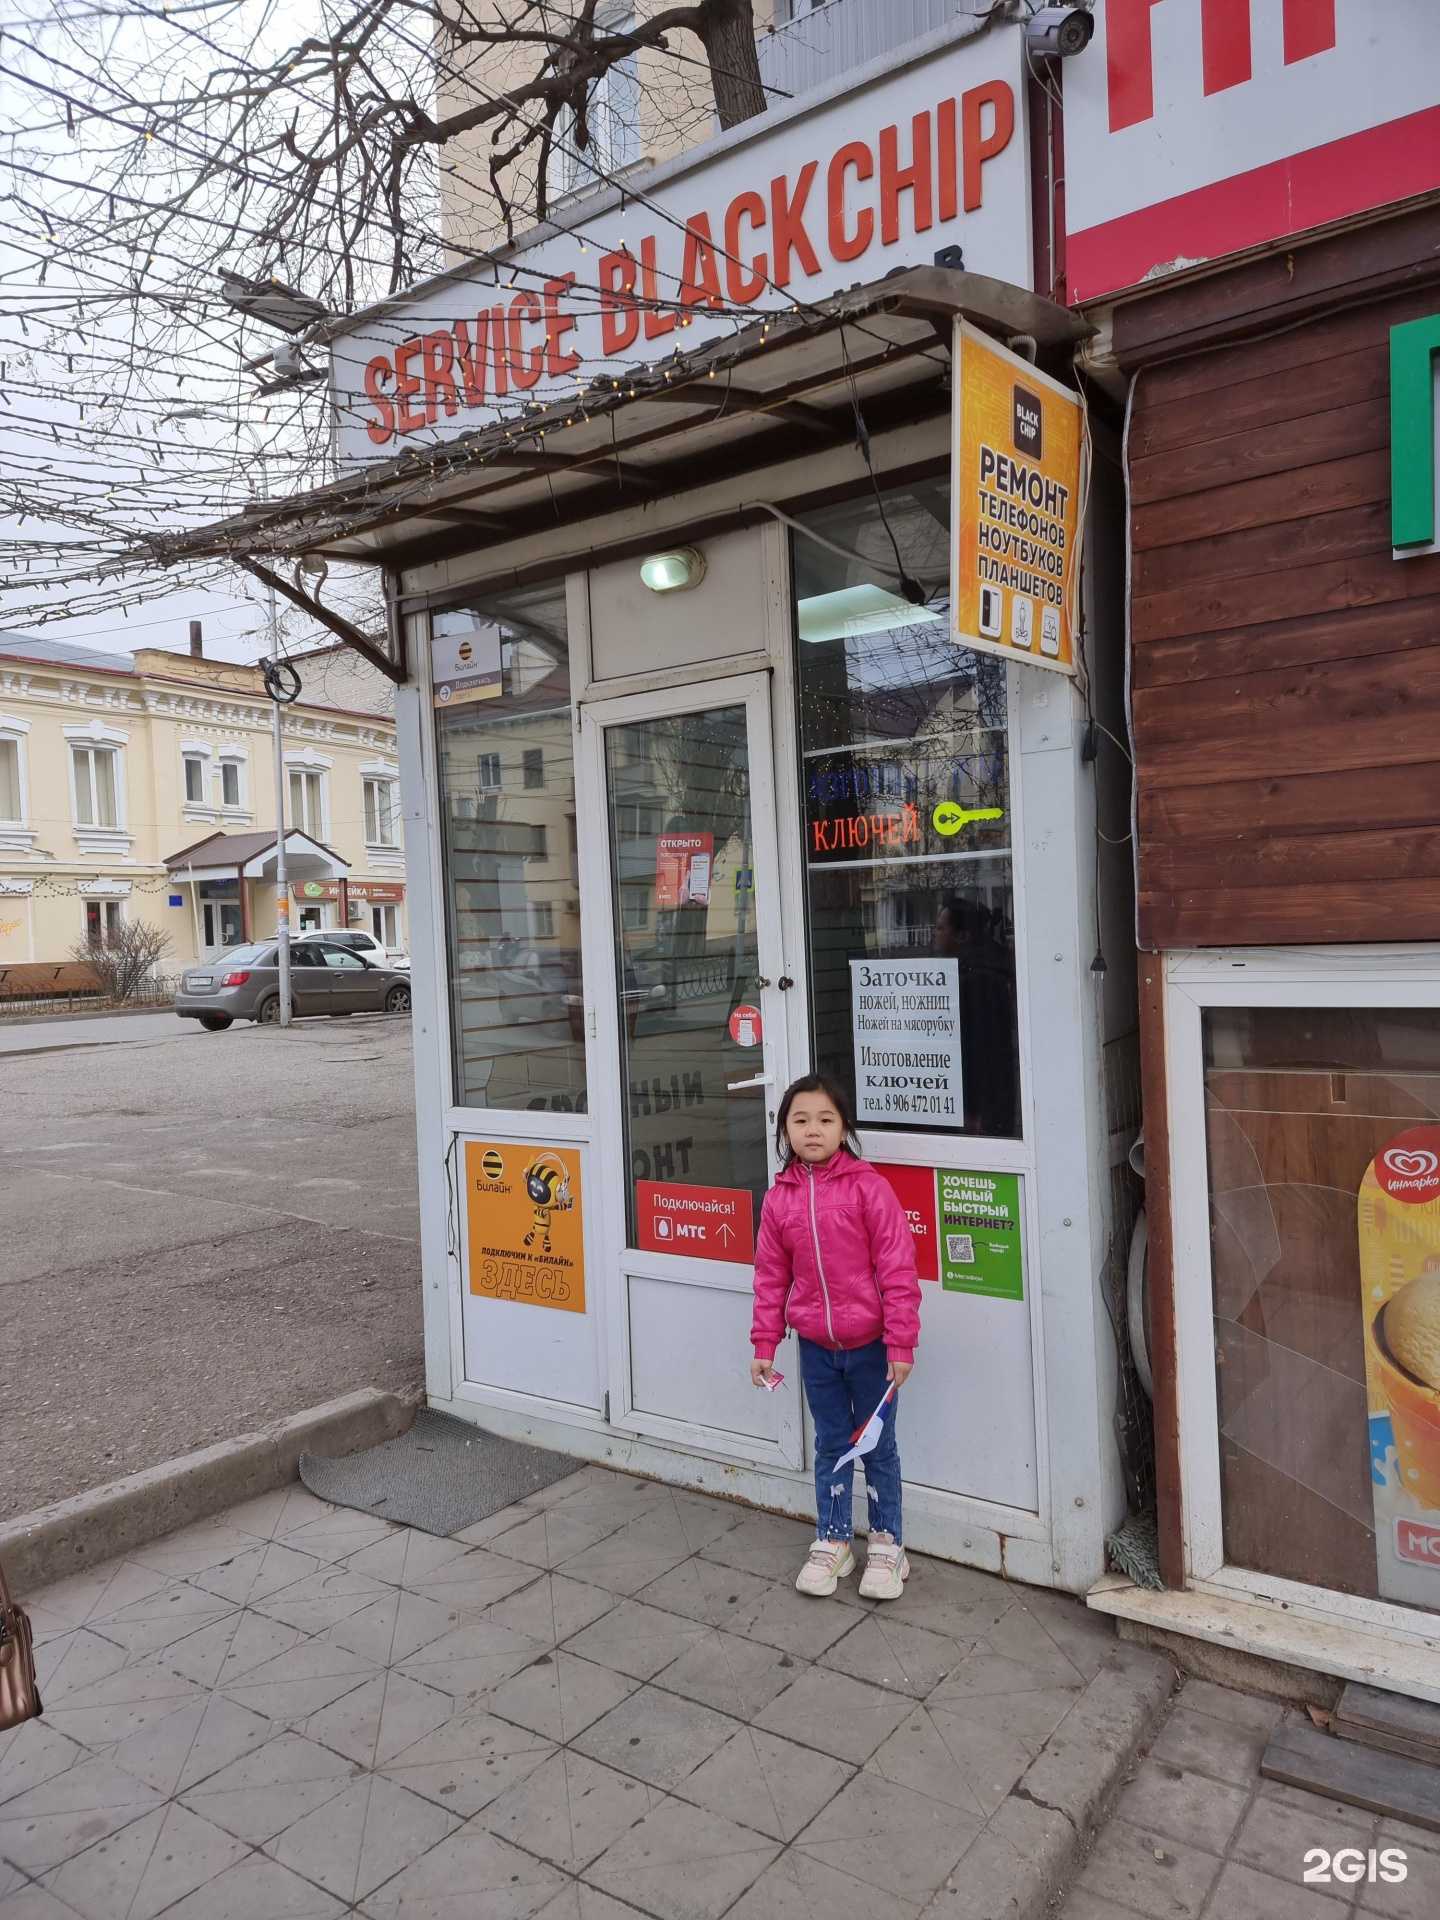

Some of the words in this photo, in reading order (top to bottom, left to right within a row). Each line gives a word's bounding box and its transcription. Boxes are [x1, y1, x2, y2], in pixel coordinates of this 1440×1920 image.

[365, 272, 583, 444] SERVICE
[599, 79, 1015, 356] BLACKCHIP
[1016, 404, 1039, 427] BLACK
[1020, 421, 1037, 440] CHIP
[980, 445, 1068, 520] РЕМОНТ
[978, 489, 1066, 549] ТЕЛЕФОНОВ
[978, 521, 1064, 577] НОУТБУКОВ
[978, 554, 1064, 606] ПЛАНШЕТОВ
[813, 801, 921, 852] КЛЮЧЕЙ
[660, 839, 702, 848] ОТКРЫТО
[329, 885, 368, 897] ИНЕЙКА
[860, 967, 947, 987] Заточка
[859, 992, 899, 1013] ножей,
[902, 995, 950, 1011] ножниц
[858, 1015, 889, 1030] Ножей
[891, 1020, 902, 1030] на
[904, 1016, 955, 1037] мясорубку
[861, 1046, 951, 1069] Изготовление
[865, 1073, 949, 1091] ключей
[864, 1097, 883, 1111] тел.
[885, 1093, 891, 1112] 8
[893, 1094, 910, 1112] 906
[911, 1095, 928, 1113] 472
[930, 1096, 941, 1114] 01
[943, 1097, 956, 1115] 41
[476, 1179, 511, 1194] Билайн
[943, 1175, 996, 1190] ХОЧЕШЬ
[653, 1193, 736, 1215] Подключайся!
[943, 1188, 993, 1202] САМЫЙ
[904, 1210, 920, 1221] ТС
[943, 1201, 1009, 1217] БЫСТРЫЙ
[676, 1223, 706, 1240] МТС
[944, 1214, 1014, 1231] ИНТЕРНЕТ?
[480, 1259, 571, 1302] ЗДЕСЬ
